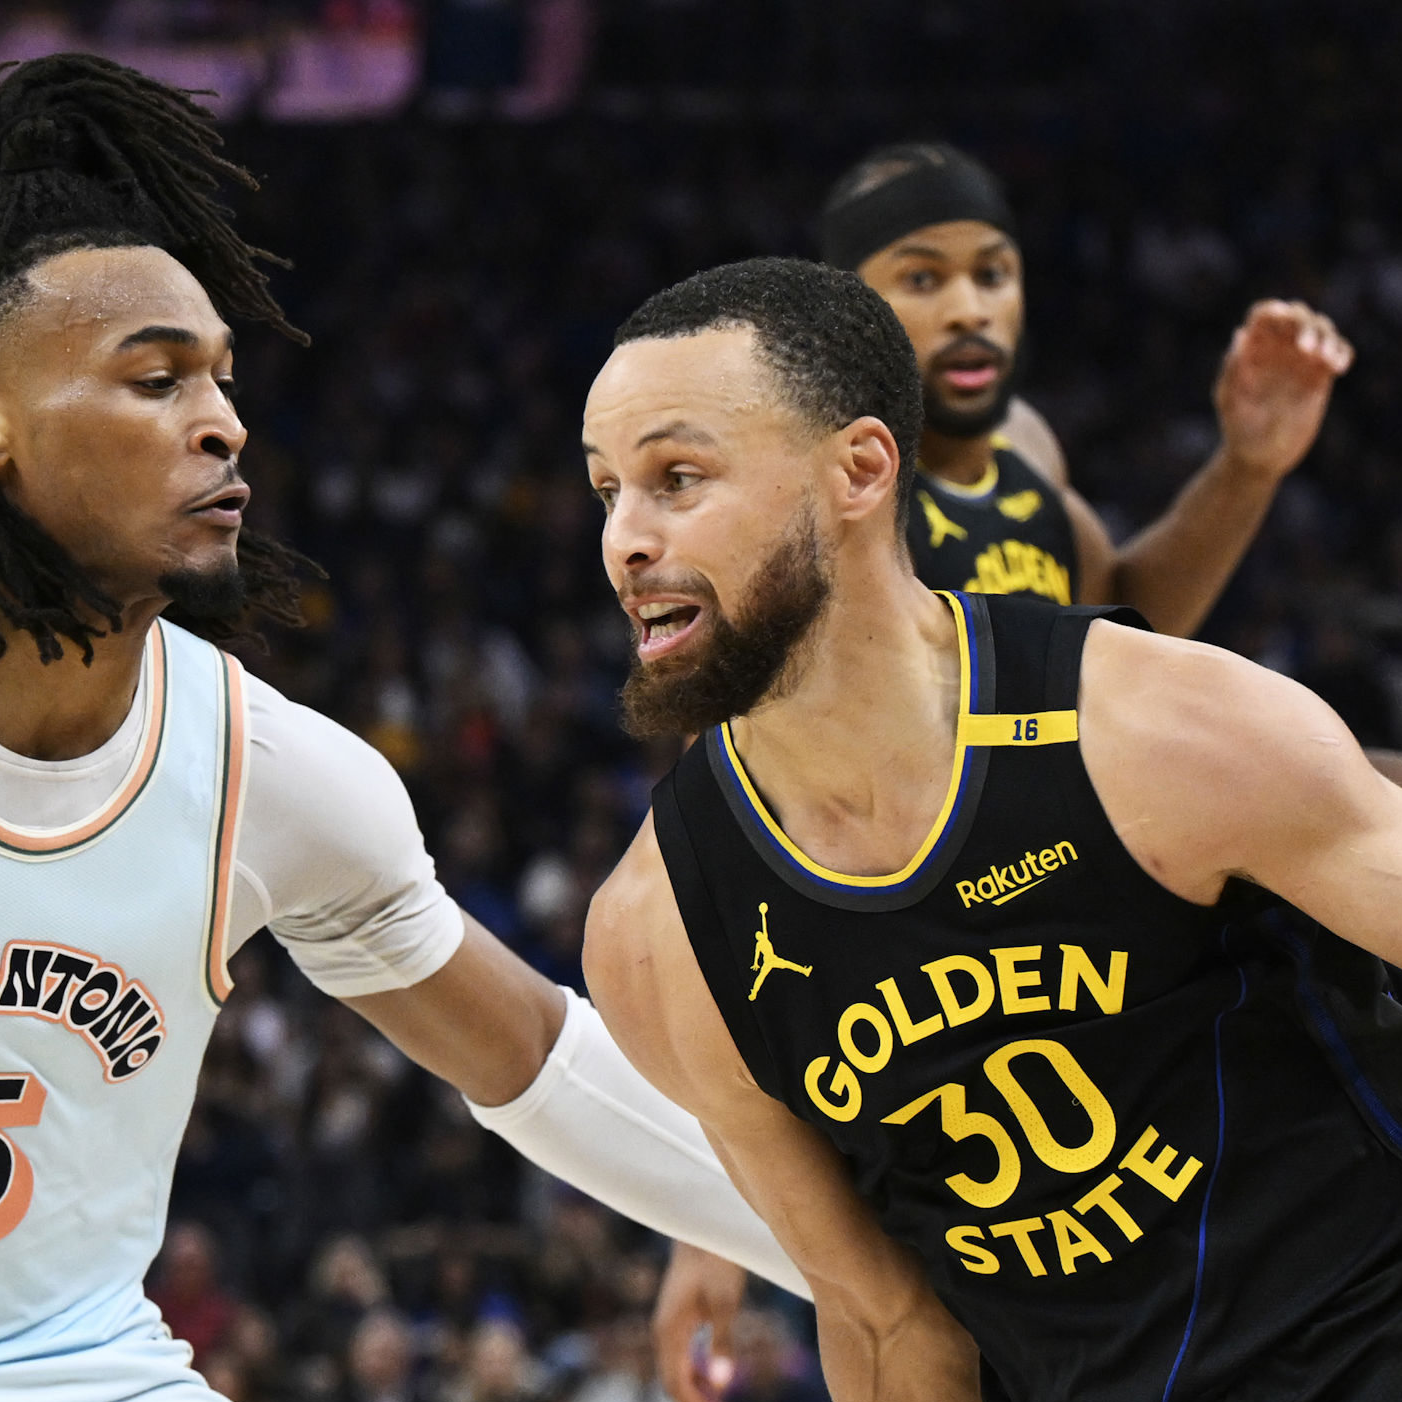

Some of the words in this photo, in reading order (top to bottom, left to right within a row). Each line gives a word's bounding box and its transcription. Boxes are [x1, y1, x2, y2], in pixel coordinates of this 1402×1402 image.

[1012, 719, 1038, 741] 16
[955, 839, 1078, 908] Rakuten
[804, 944, 1128, 1122] GOLDEN
[880, 1038, 1117, 1208] 30
[945, 1125, 1203, 1277] STATE
